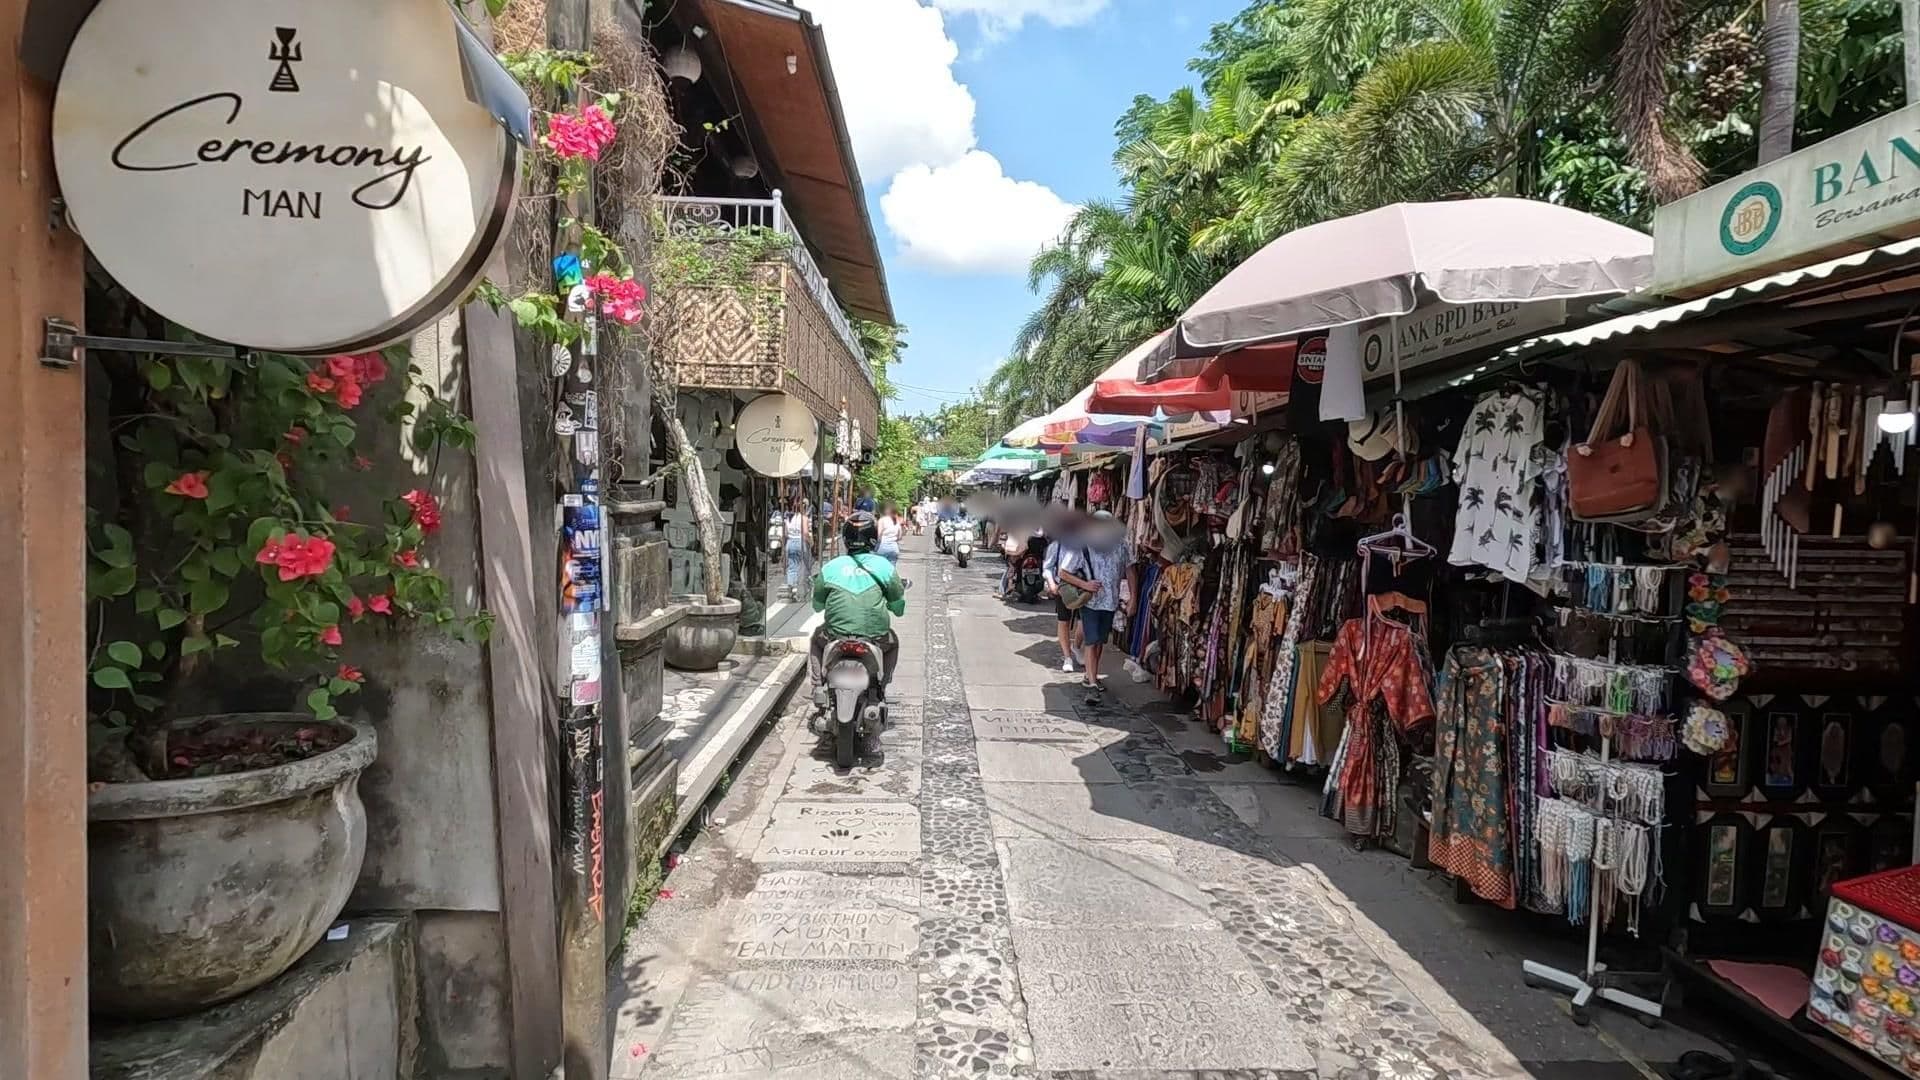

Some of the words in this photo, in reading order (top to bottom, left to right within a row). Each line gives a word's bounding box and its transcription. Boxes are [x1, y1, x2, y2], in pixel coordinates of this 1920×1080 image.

[111, 92, 432, 210] Ceremony
[241, 188, 322, 219] MAN
[1435, 306, 1467, 337] BPD
[746, 427, 805, 451] Ceremony
[801, 941, 904, 957] MARTIN
